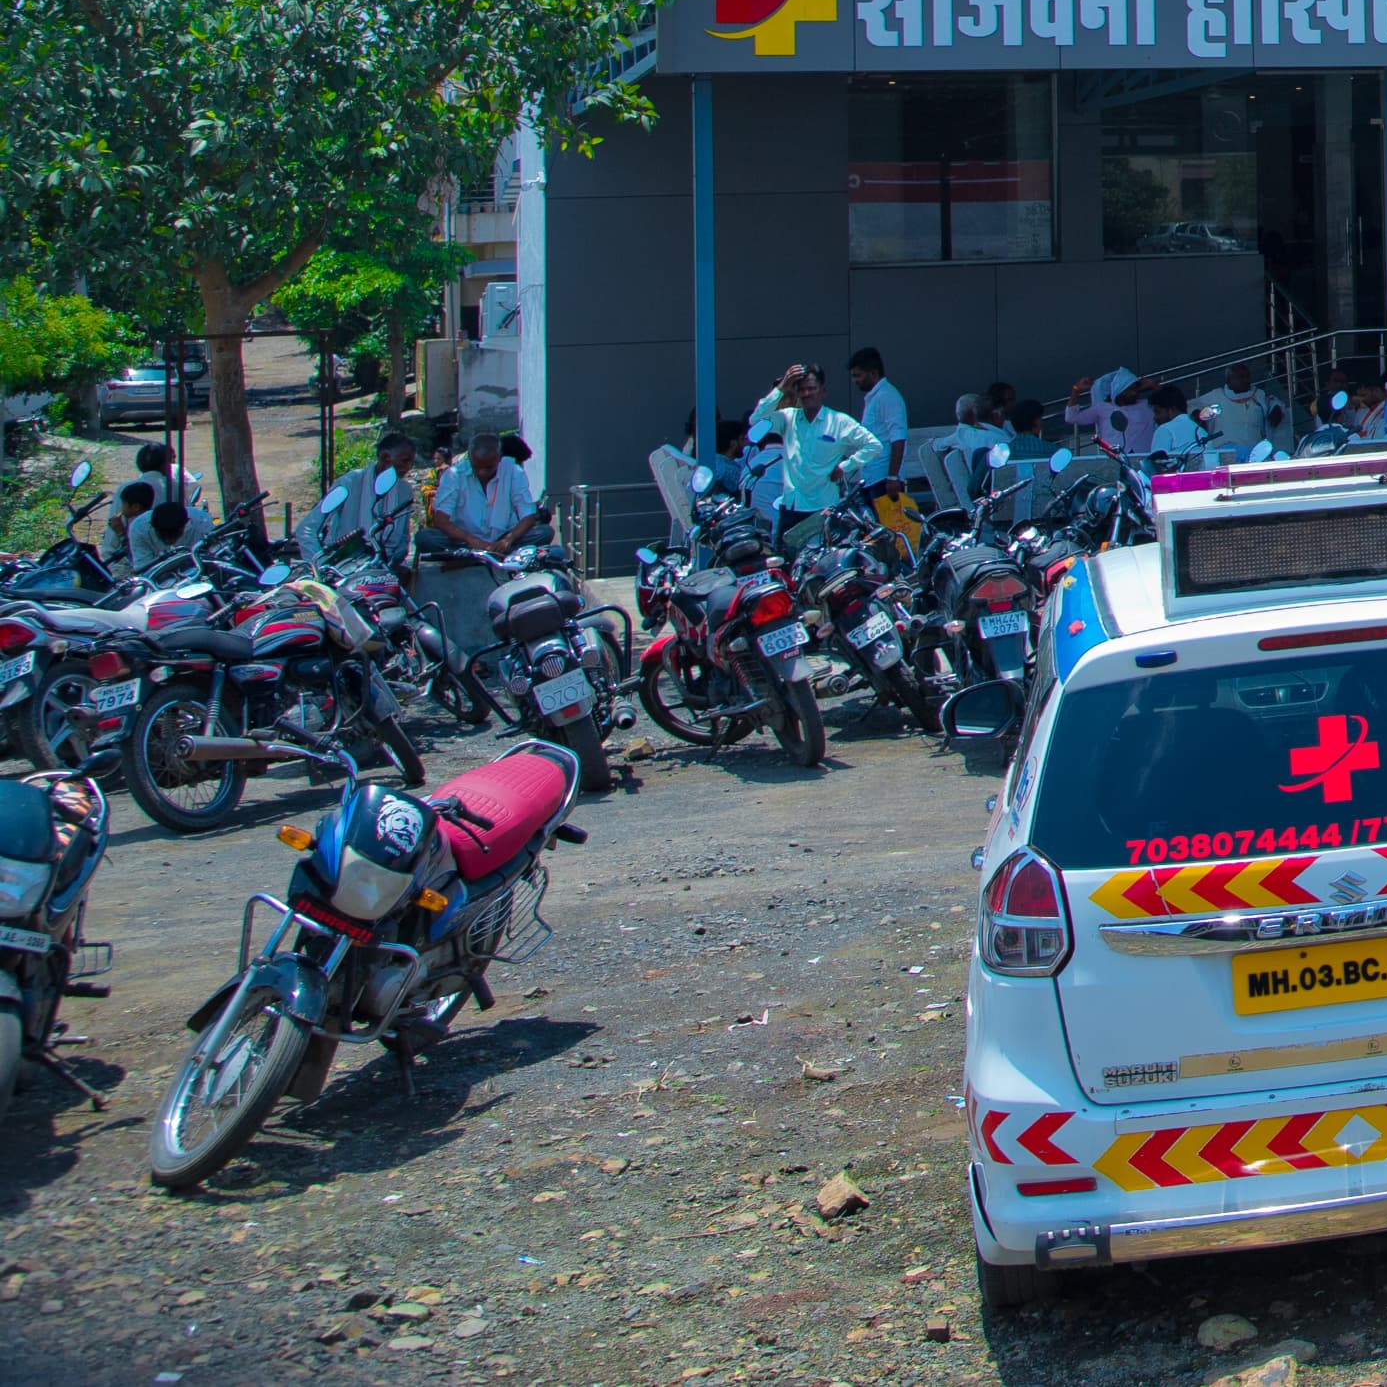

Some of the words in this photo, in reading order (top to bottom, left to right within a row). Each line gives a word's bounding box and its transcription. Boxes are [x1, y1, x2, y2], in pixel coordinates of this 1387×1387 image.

[97, 691, 134, 710] 7974
[1125, 822, 1342, 866] 7038074444
[1102, 1062, 1178, 1077] MARUTI
[1102, 1074, 1178, 1088] SUZUKI
